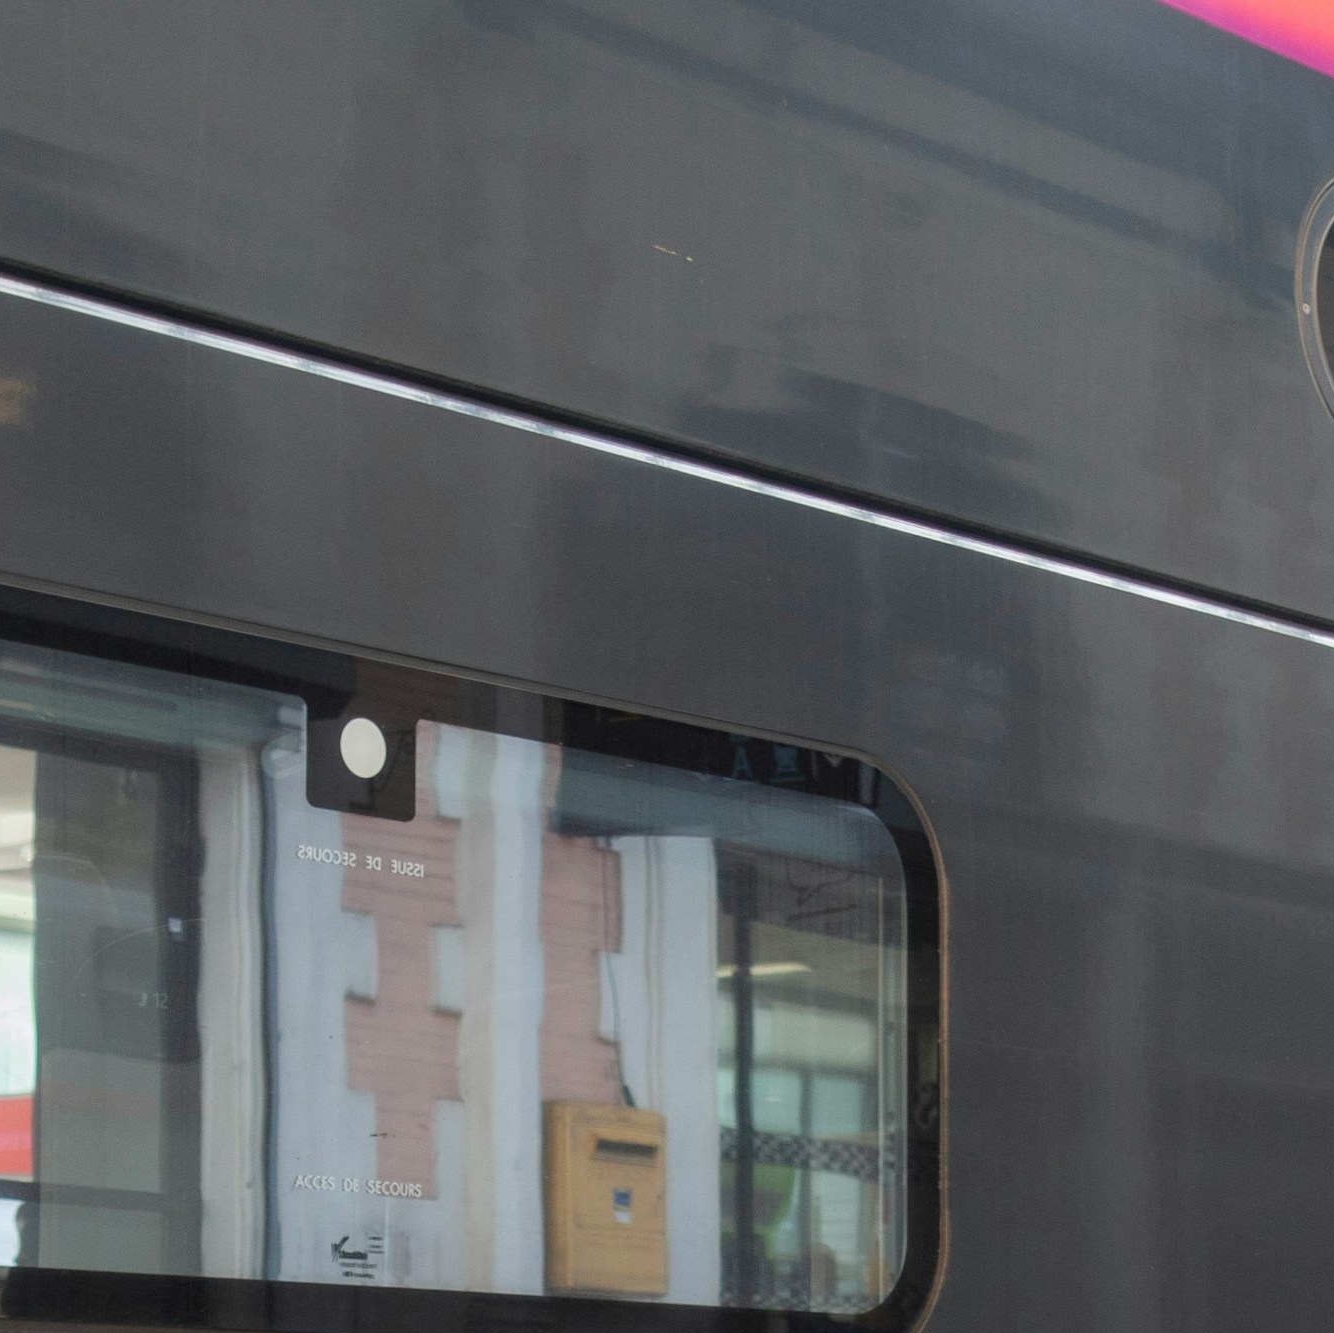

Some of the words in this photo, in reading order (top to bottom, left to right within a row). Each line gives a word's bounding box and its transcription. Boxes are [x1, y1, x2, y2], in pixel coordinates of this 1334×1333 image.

[294, 1174, 336, 1191] ACCES
[342, 1177, 359, 1193] DE
[367, 1179, 423, 1198] SECOURS
